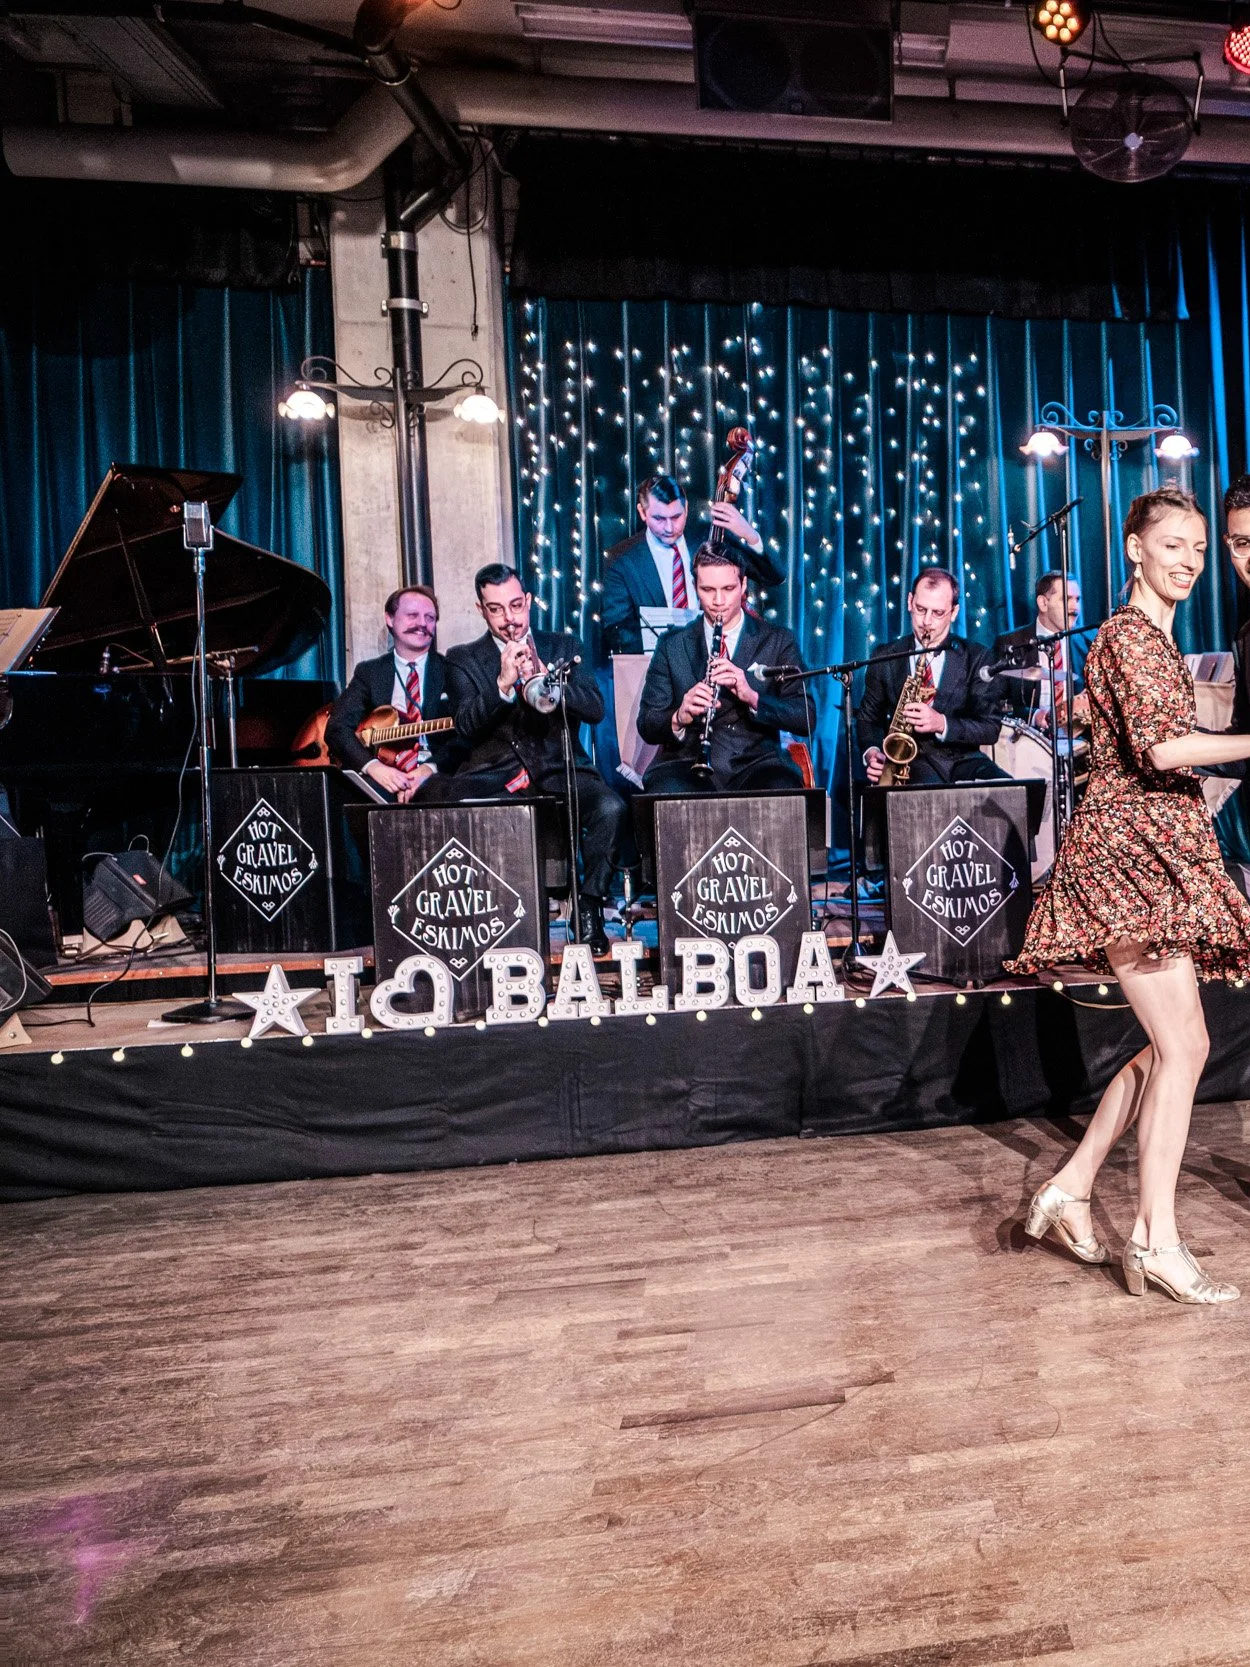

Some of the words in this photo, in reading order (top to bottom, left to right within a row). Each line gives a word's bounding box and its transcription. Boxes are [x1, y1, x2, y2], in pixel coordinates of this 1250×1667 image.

[247, 821, 282, 841] HOT
[236, 841, 298, 867] GRAVEL
[711, 851, 755, 875] HOT
[938, 838, 979, 861] HOT
[232, 864, 303, 894] ESKIMOS
[432, 862, 478, 888] HOT
[926, 860, 997, 887] GRAVEL
[416, 888, 499, 920] GRAVEL
[696, 874, 773, 904] GRAVEL
[921, 887, 1002, 919] ESKIMOS
[410, 916, 506, 950] ESKIMOS
[692, 903, 779, 934] ESKIMOS
[324, 955, 365, 1035] I
[483, 930, 845, 1026] BALBOA
